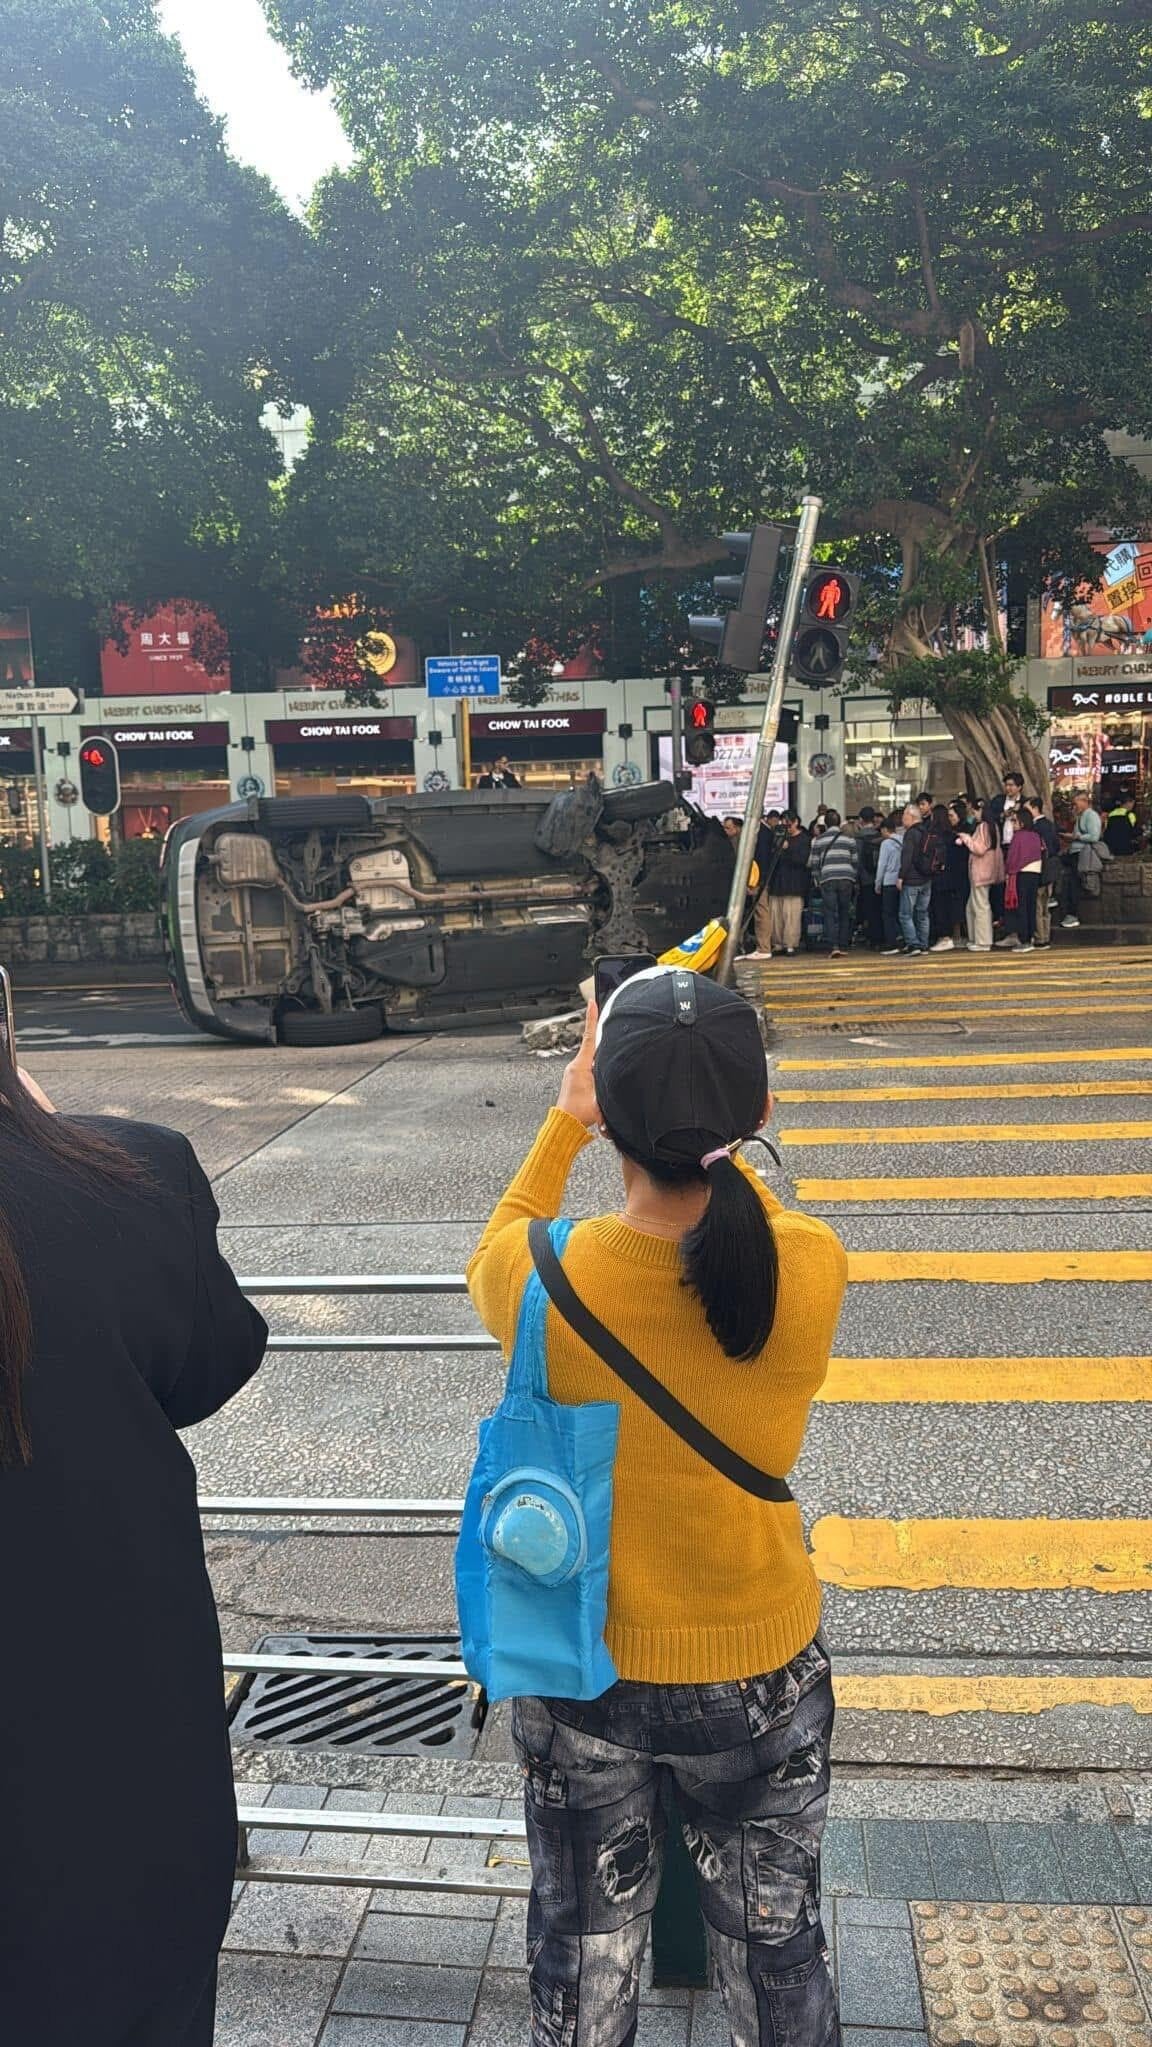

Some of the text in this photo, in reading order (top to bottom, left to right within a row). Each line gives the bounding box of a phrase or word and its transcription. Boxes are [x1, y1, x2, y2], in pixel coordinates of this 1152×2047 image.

[1107, 581, 1140, 609] 置換
[140, 631, 190, 645] 周大福
[1077, 664, 1119, 677] MERRY
[6, 691, 33, 699] Nathan
[1105, 692, 1144, 704] NOBLE
[104, 706, 139, 718] MERRY
[289, 700, 326, 712] MERRY
[300, 724, 381, 736] CHOW TAI FOOK
[488, 718, 570, 730] CHOW TAI FOOK
[114, 730, 194, 742] CHOW TAI FOOK
